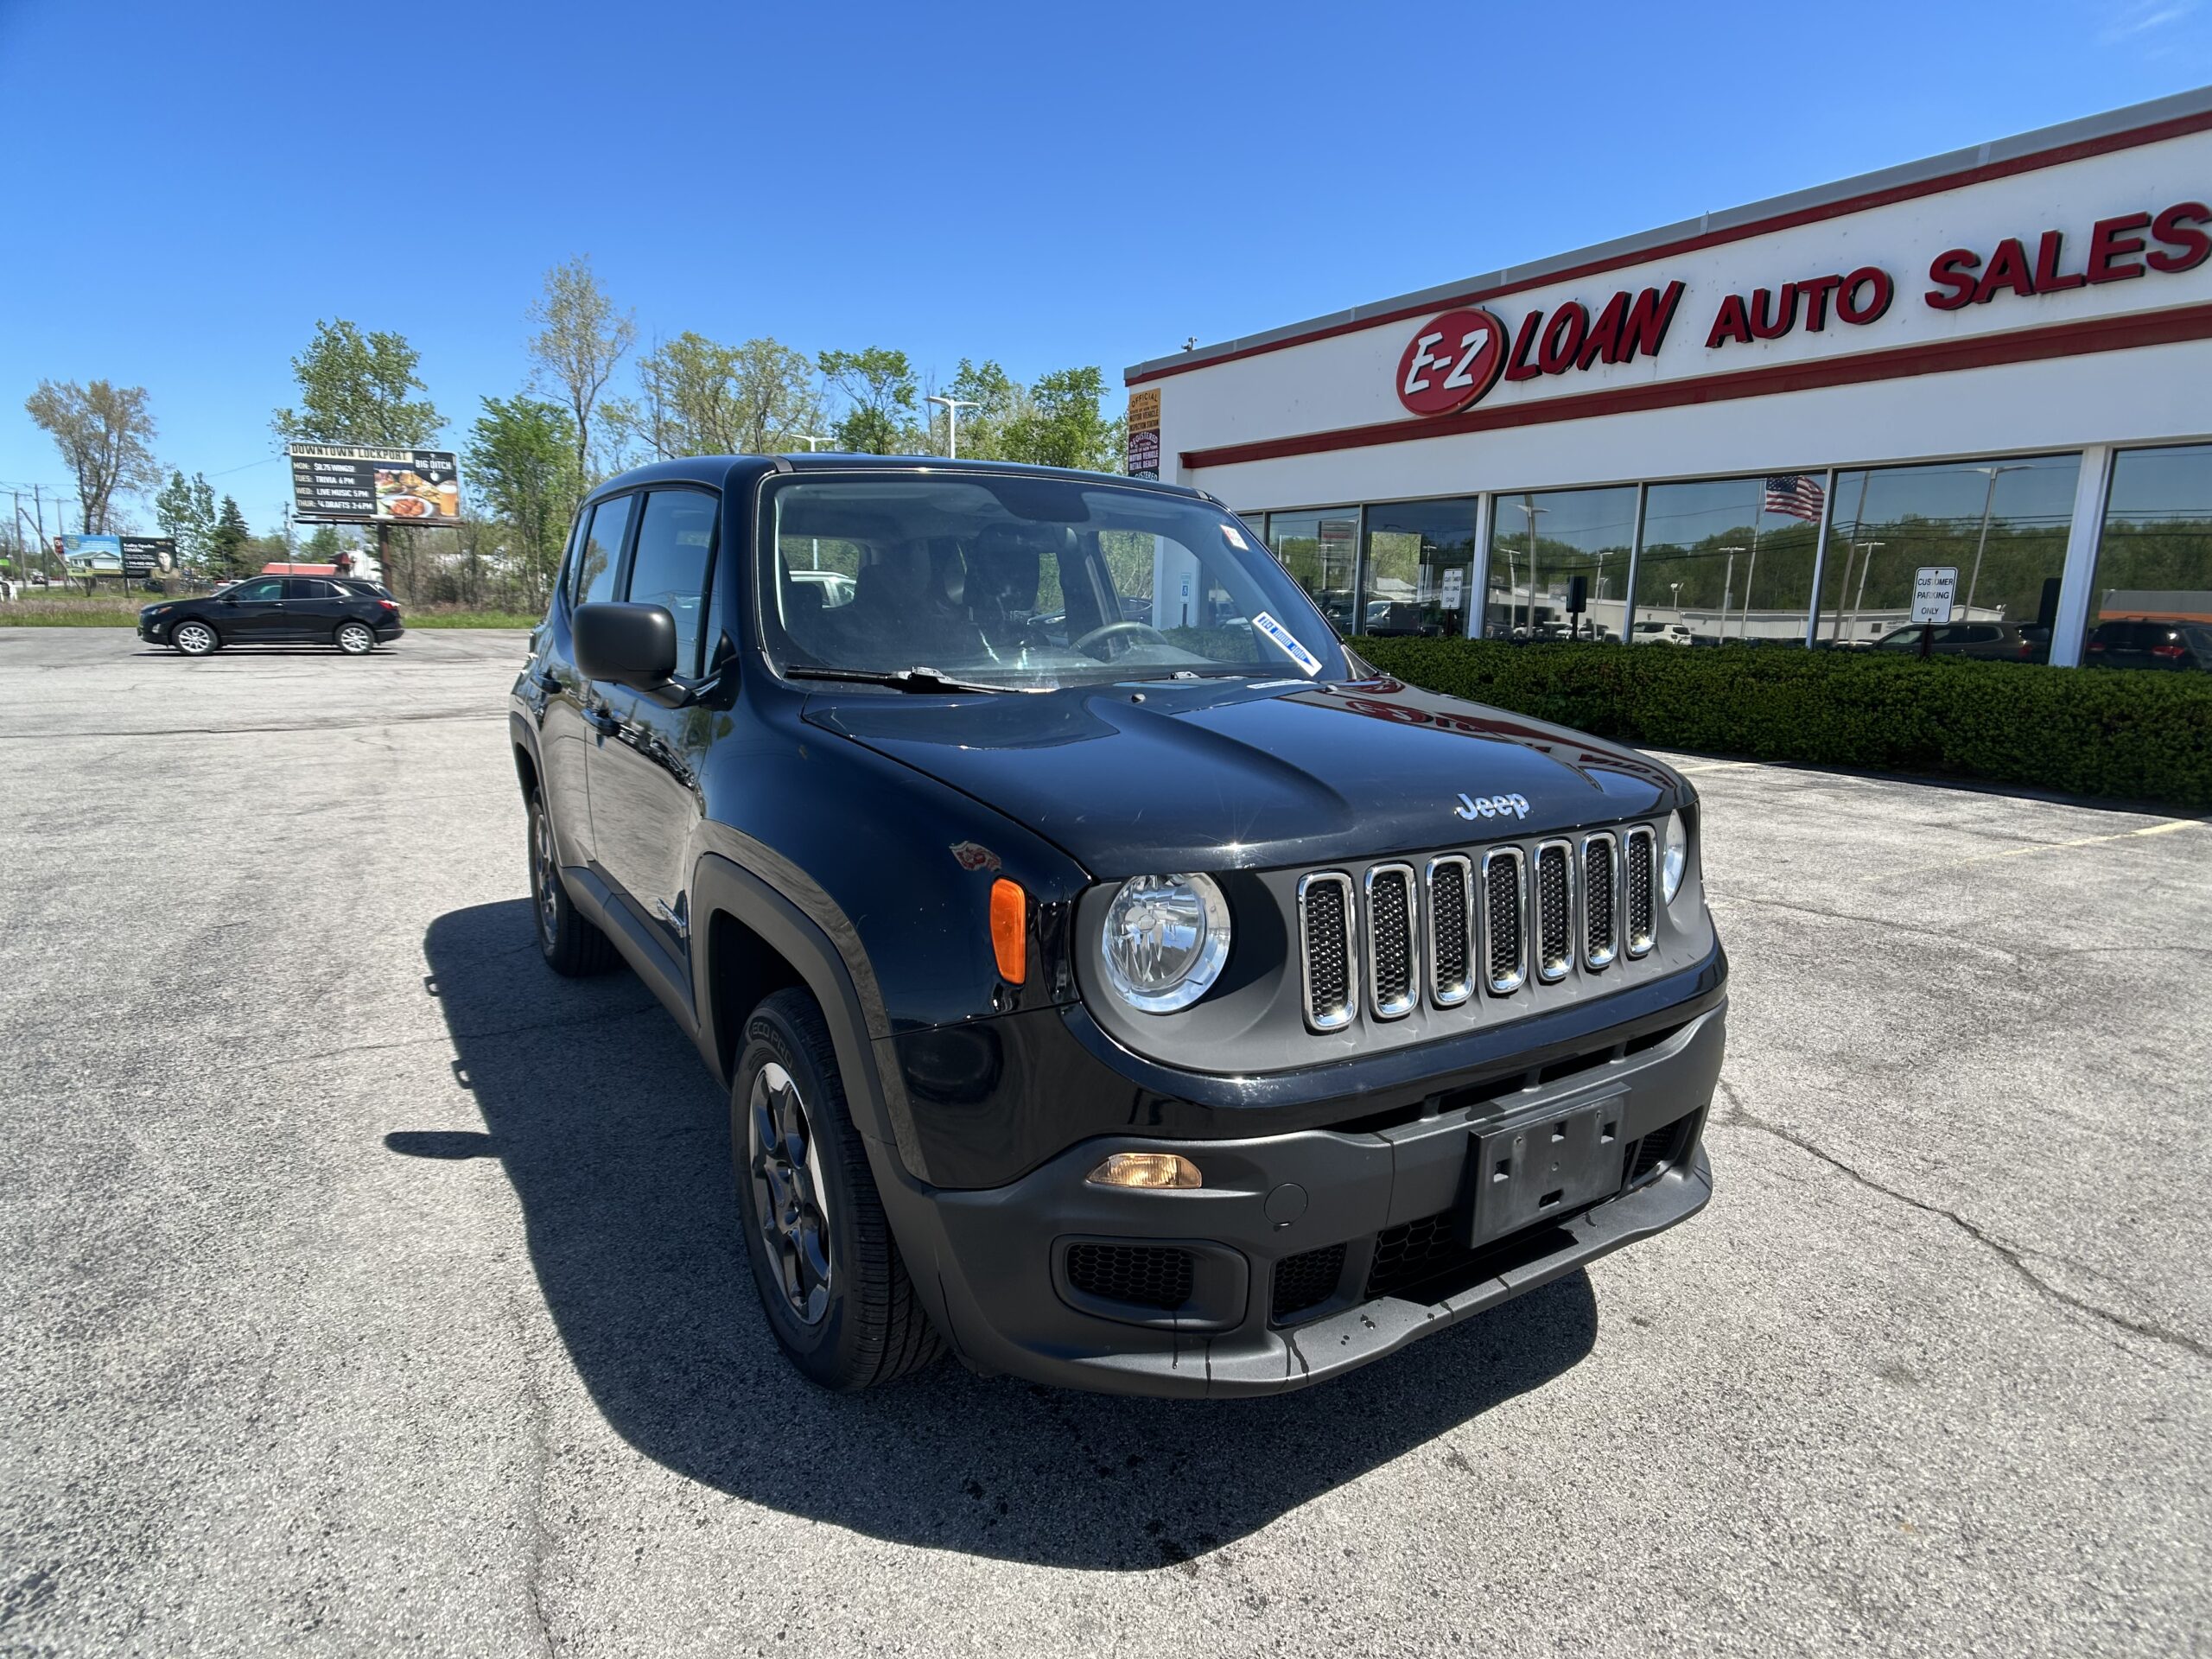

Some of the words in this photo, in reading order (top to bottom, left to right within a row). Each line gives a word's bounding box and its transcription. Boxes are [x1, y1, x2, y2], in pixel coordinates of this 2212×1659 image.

[1404, 327, 1489, 395] E-Z
[1504, 280, 1686, 381] LOAN
[1704, 265, 1895, 349] AUTO
[1924, 201, 2212, 311] SALES
[1131, 392, 1158, 408] OFFICIAL
[1129, 431, 1159, 449] REGISTERED
[291, 444, 354, 457] DOWNTOWN
[358, 448, 407, 461] LOCKPORT
[415, 459, 429, 469] BIG
[429, 460, 453, 470] DITCH
[1142, 458, 1158, 468] DEALER
[343, 477, 355, 486] PM
[1916, 591, 1949, 600] PARKING
[1921, 607, 1939, 615] ONLY
[1453, 793, 1530, 821] Jeep
[752, 1021, 770, 1038] ECO
[771, 1028, 793, 1070] PRO
